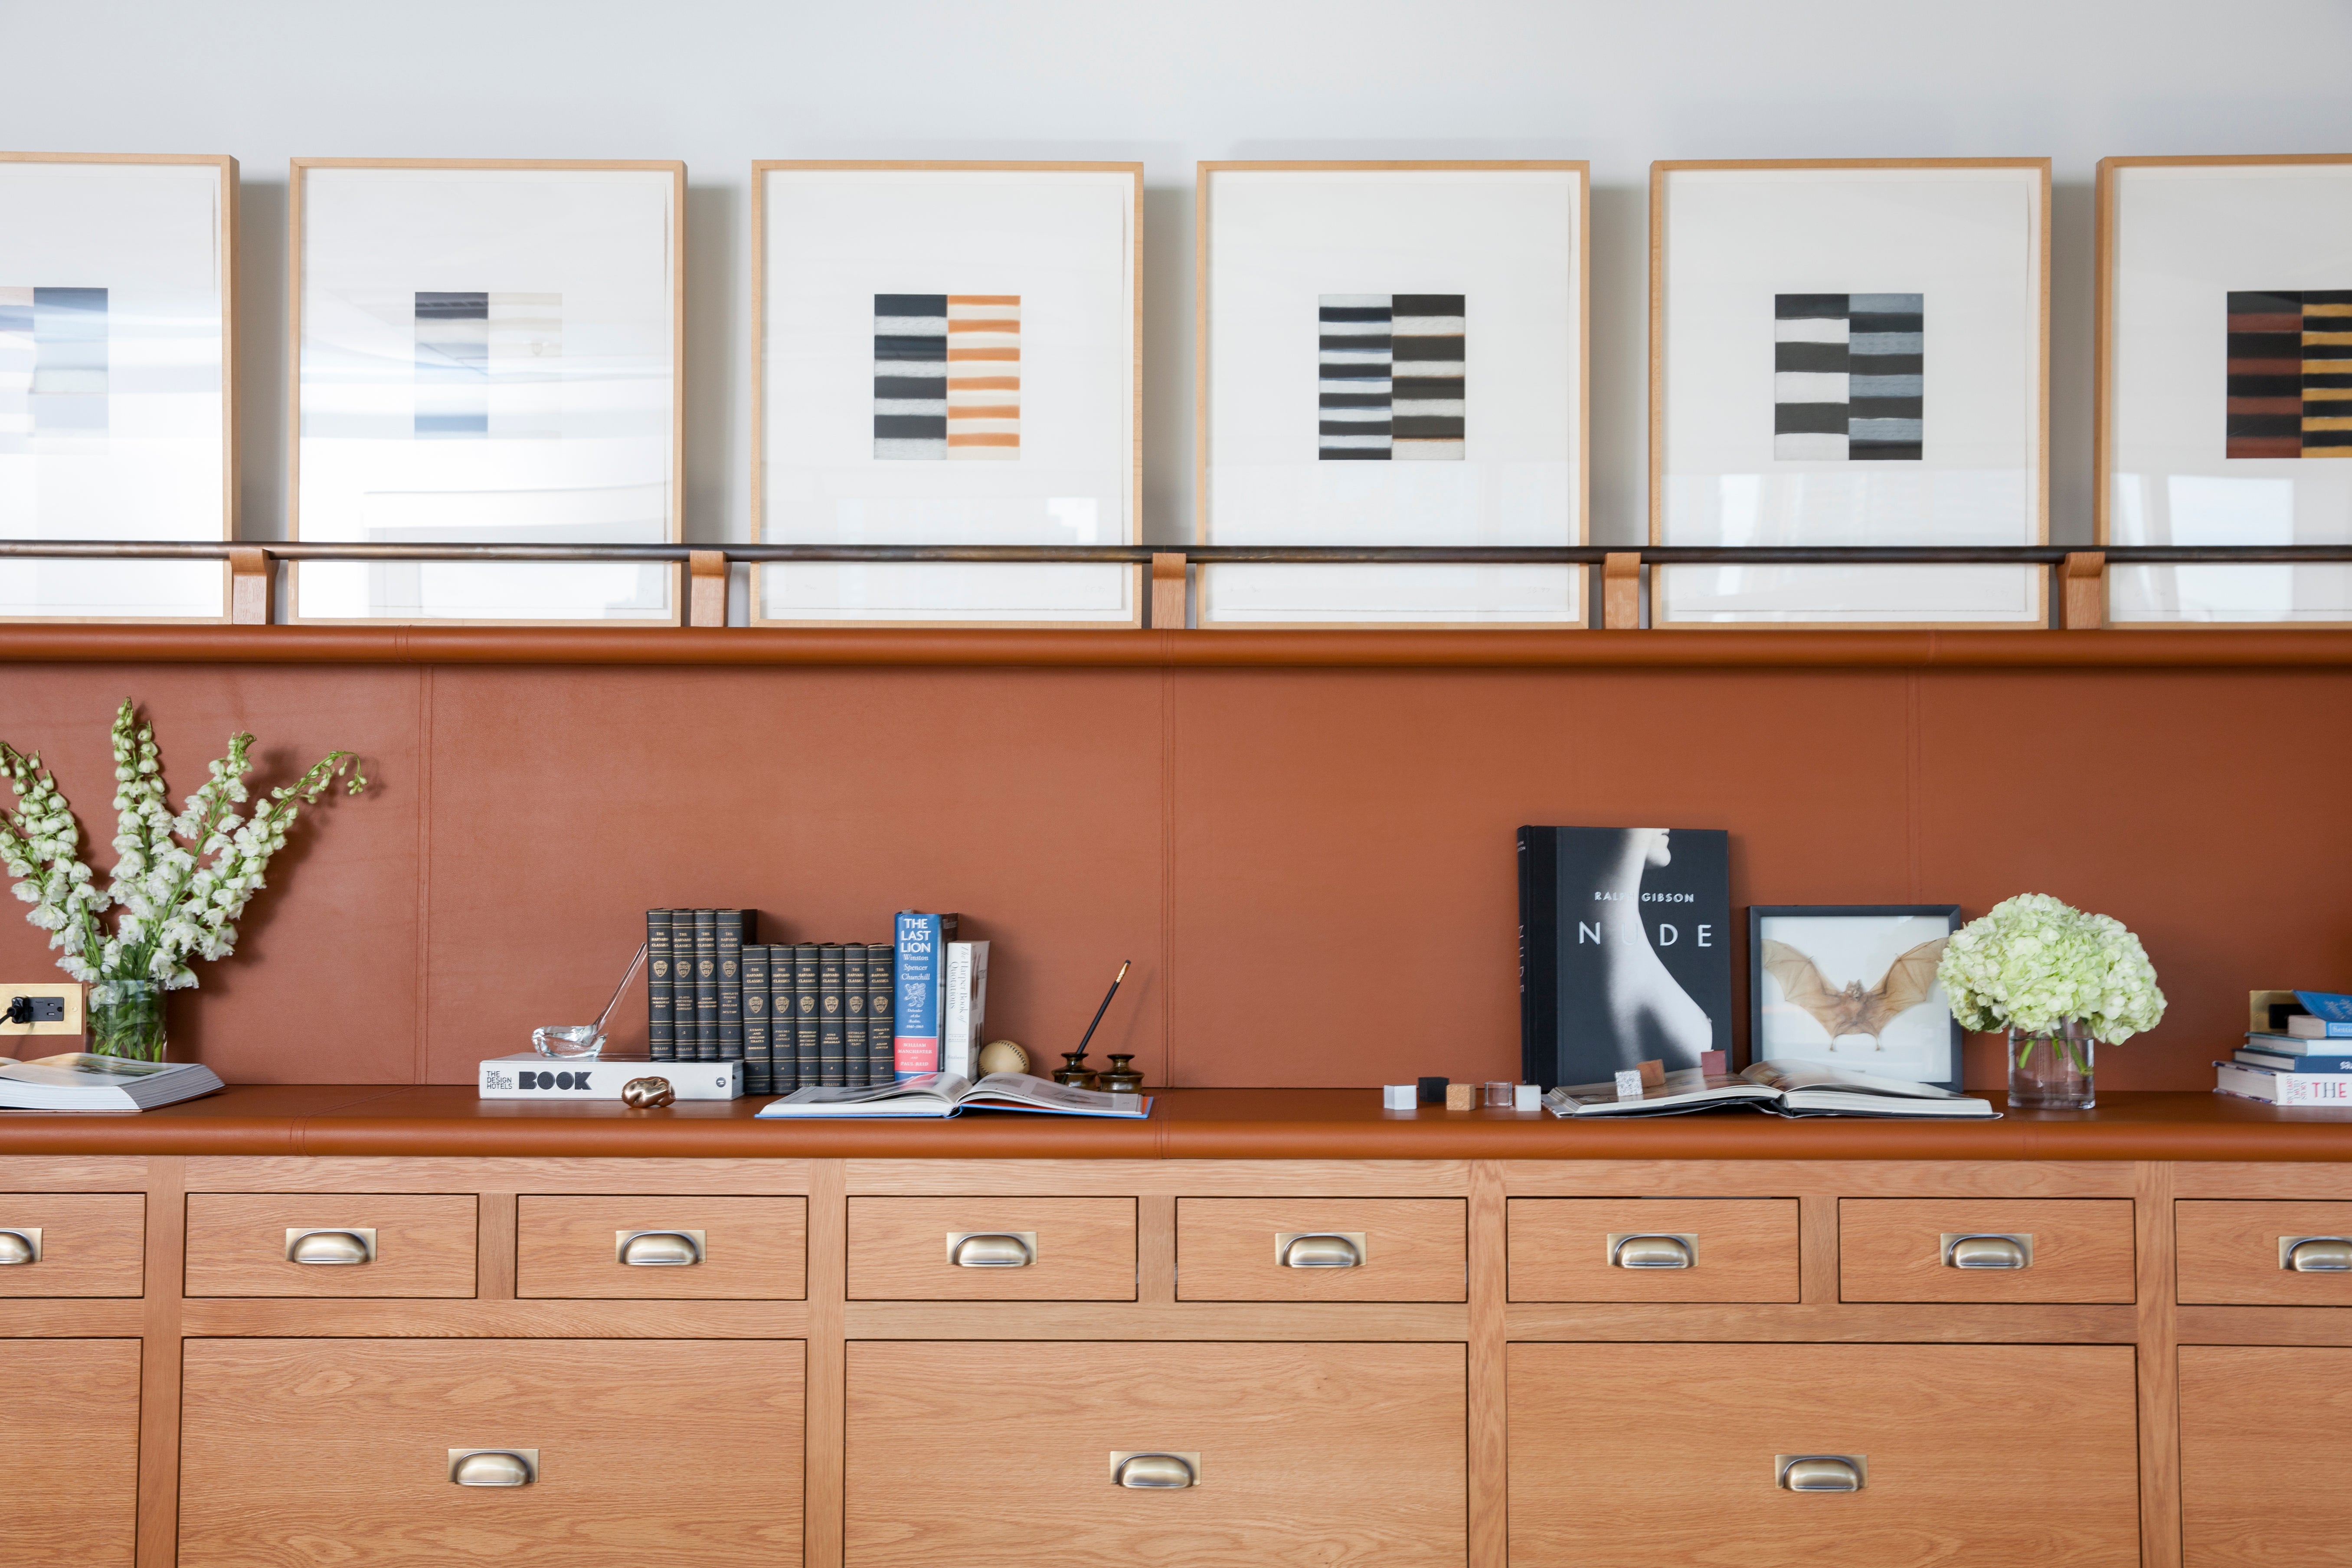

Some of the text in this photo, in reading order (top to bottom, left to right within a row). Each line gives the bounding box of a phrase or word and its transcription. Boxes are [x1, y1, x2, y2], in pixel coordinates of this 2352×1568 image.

[1594, 891, 1694, 903] RALPH GIBSON
[903, 919, 928, 929] THE
[900, 930, 931, 941] LAST
[1579, 920, 1712, 947] NUDE
[900, 942, 931, 953] LION
[903, 963, 928, 972] Spencer
[958, 961, 968, 990] Harper
[948, 962, 959, 1009] Quotations
[959, 993, 968, 1013] Book
[957, 1015, 967, 1024] of
[519, 1071, 593, 1090] BOOK
[2311, 1082, 2347, 1098] THE
